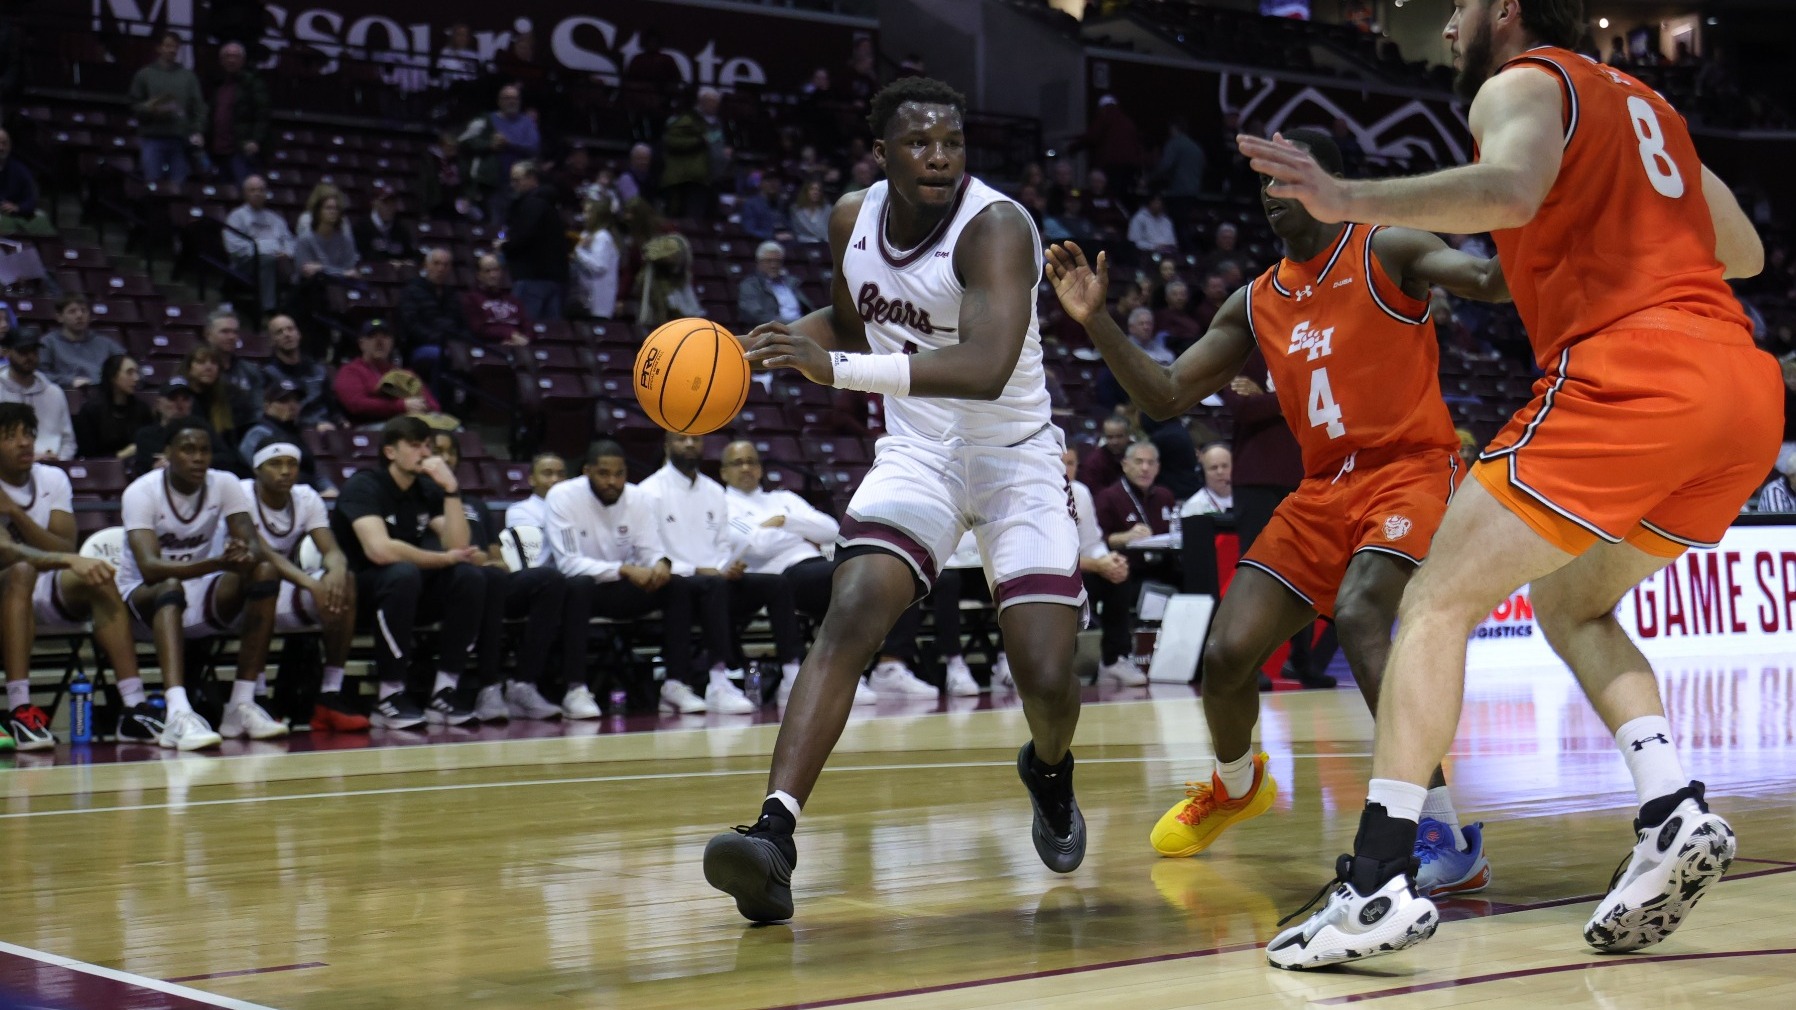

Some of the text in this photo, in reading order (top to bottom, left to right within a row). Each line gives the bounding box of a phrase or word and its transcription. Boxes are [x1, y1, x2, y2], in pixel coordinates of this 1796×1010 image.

[1627, 95, 1685, 199] 8
[858, 281, 957, 335] Bears
[641, 347, 658, 388] PRO
[1308, 367, 1346, 440] 4
[1490, 594, 1533, 622] ON
[1634, 551, 1747, 638] GAME
